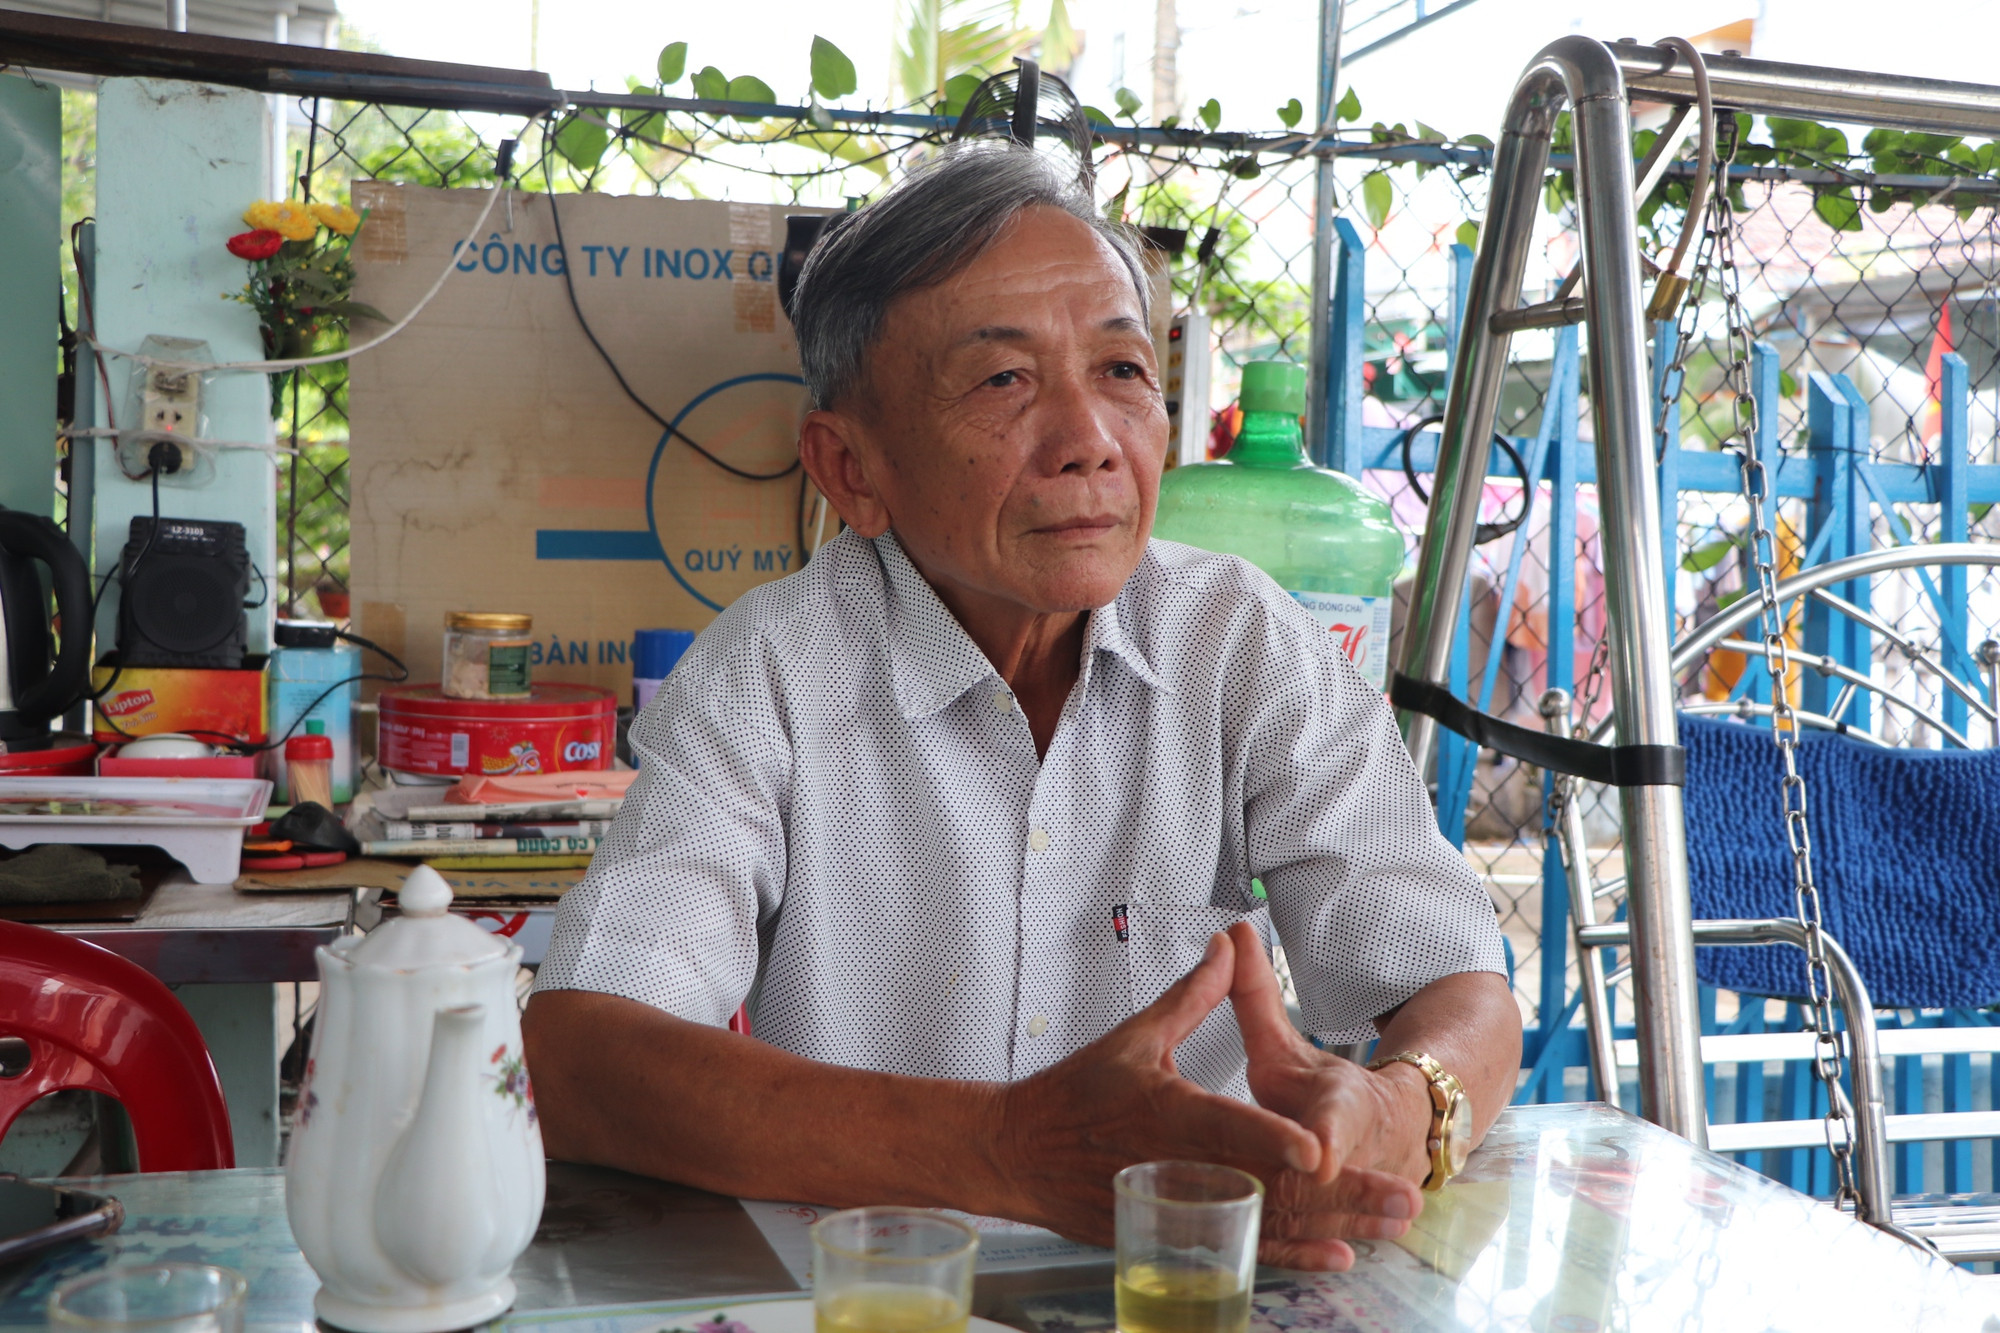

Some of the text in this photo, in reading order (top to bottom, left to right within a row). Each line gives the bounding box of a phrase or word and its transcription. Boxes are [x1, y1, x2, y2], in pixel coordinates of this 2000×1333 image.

[453, 232, 566, 277] CÔNG
[581, 246, 630, 277] TY
[644, 247, 734, 280] INOX
[684, 544, 793, 572] QUÝ MỸ
[531, 639, 636, 666] BÀN IN
[105, 692, 152, 715] Lipton
[1116, 907, 1128, 938] FASHION
